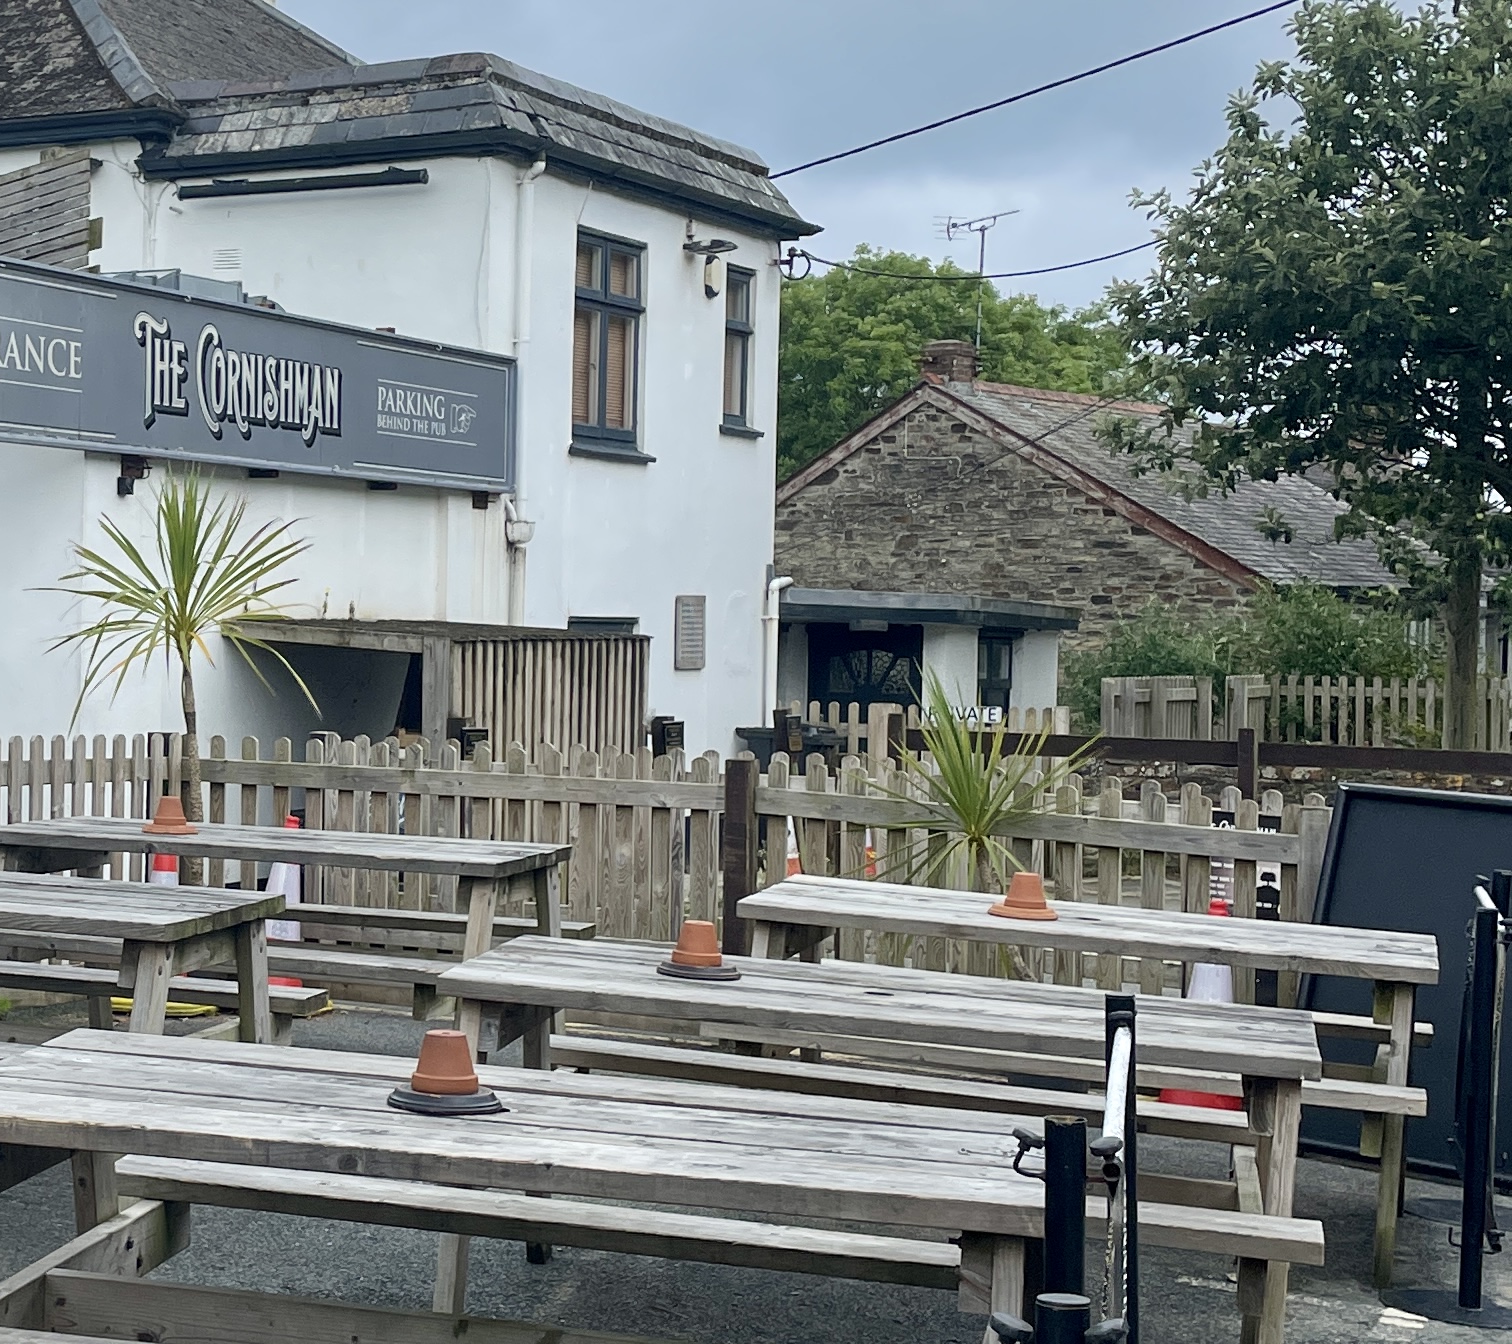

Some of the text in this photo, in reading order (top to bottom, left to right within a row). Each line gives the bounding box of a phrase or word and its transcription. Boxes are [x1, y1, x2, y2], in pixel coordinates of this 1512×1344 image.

[133, 311, 342, 447] THE CORNISHMAN
[377, 386, 446, 420] PARKING
[376, 413, 447, 436] BEHIND THE PUB
